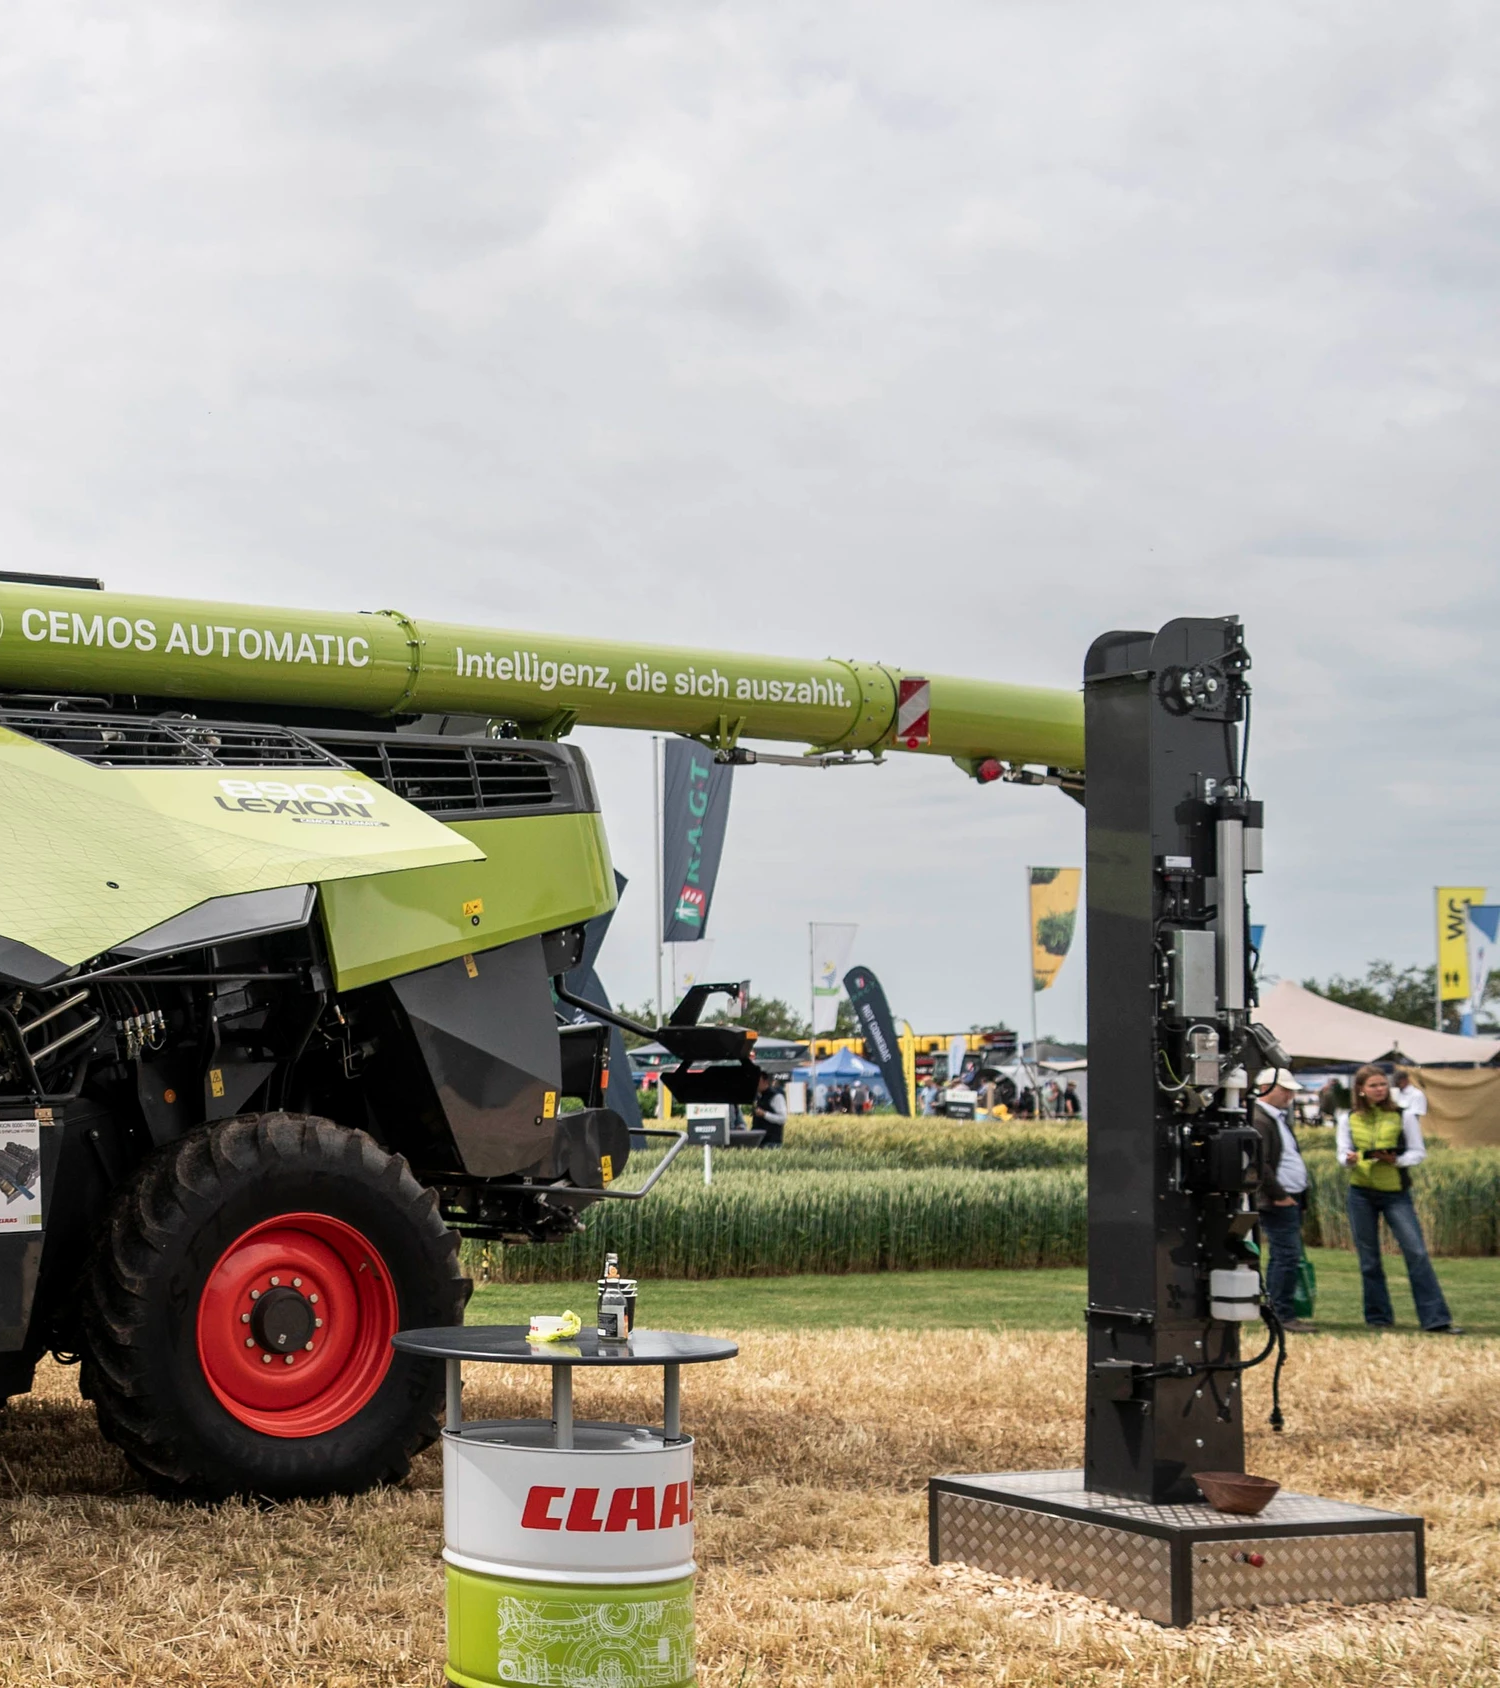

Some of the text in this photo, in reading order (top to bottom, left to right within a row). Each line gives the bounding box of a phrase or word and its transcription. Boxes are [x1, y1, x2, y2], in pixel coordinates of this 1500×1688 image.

[22, 608, 369, 667] CEMOS AUTOMATIC
[456, 647, 852, 708] Intelligenz, die sich auszahlt.
[214, 796, 373, 818] LEXION
[218, 780, 376, 804] 8900
[521, 1477, 694, 1532] CLAA
